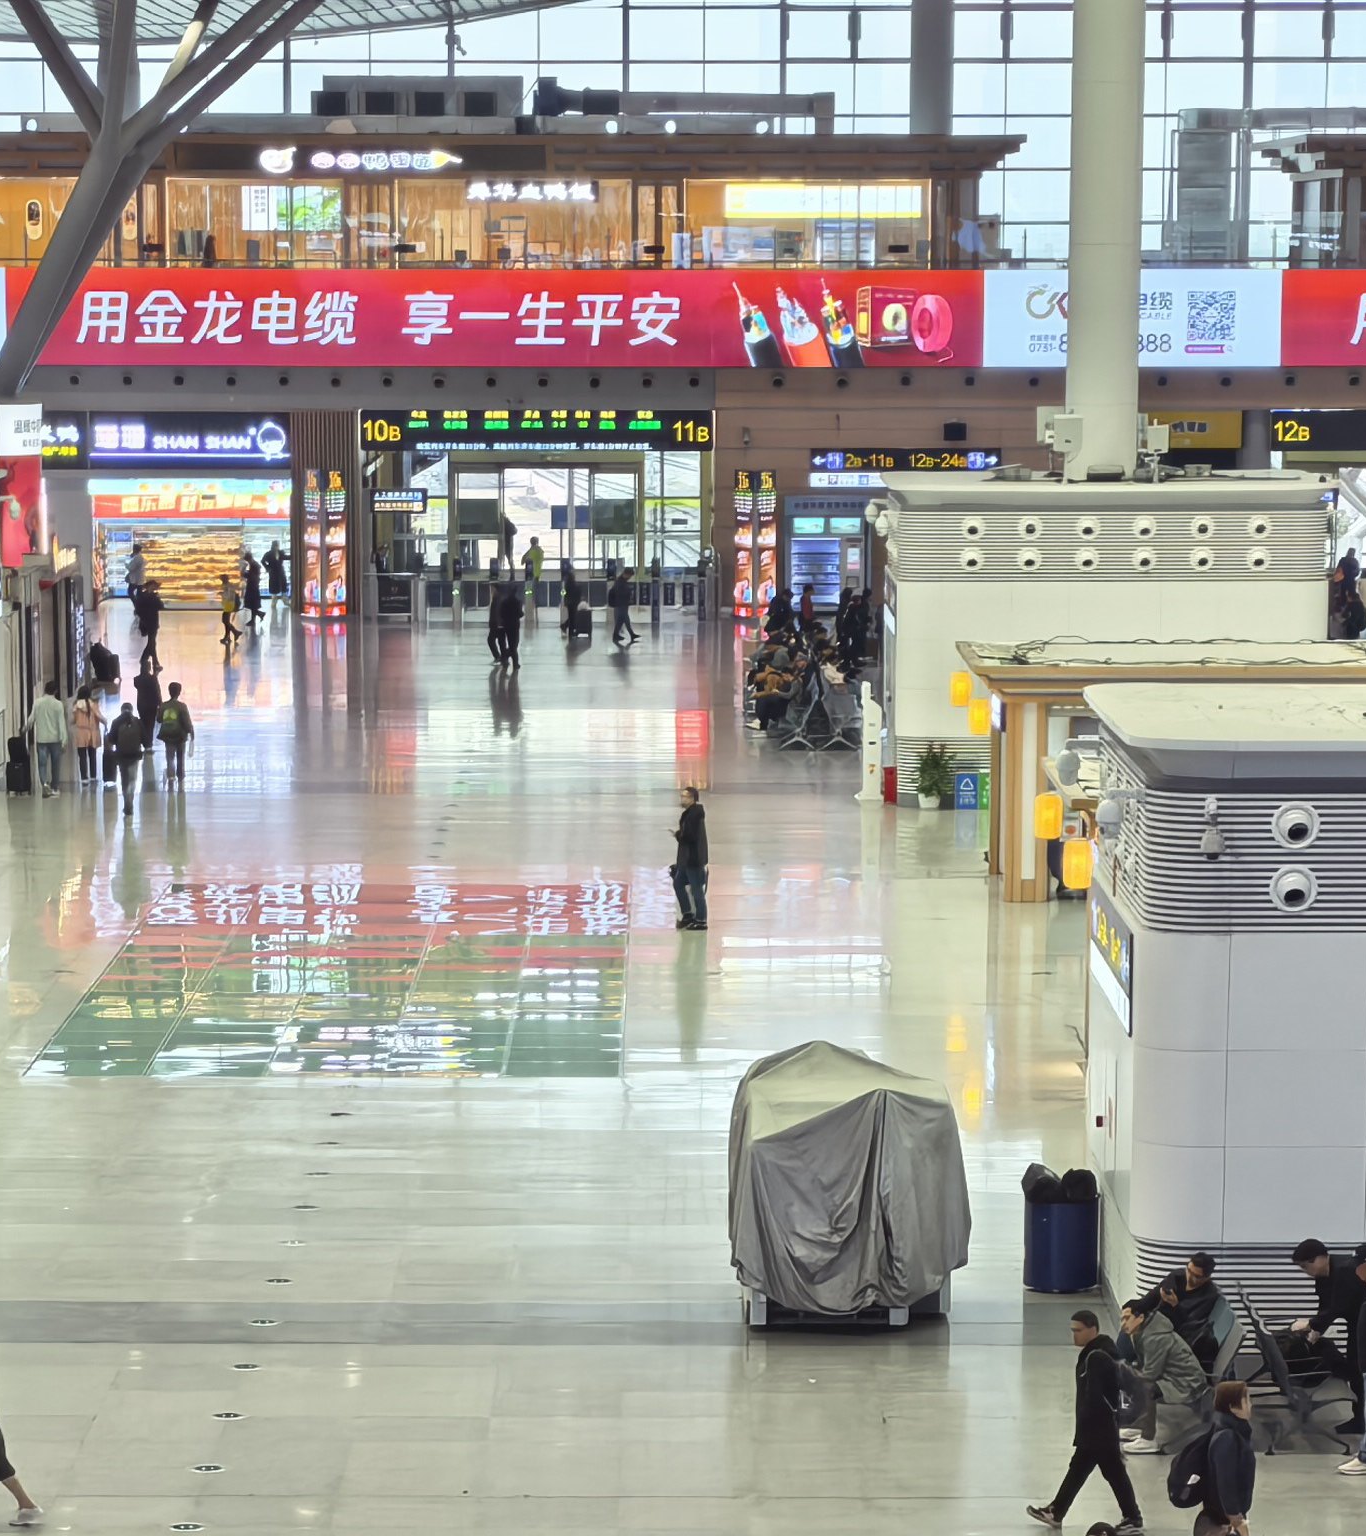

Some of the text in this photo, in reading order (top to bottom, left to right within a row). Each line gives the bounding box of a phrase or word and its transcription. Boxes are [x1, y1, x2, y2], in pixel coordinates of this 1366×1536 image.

[75, 289, 682, 347] 用金龙电缆 享一生平安
[152, 434, 200, 450] SHAN
[204, 434, 252, 450] SHAN
[362, 420, 402, 442] 10B
[672, 420, 711, 442] 11B
[1273, 420, 1311, 442] 12B
